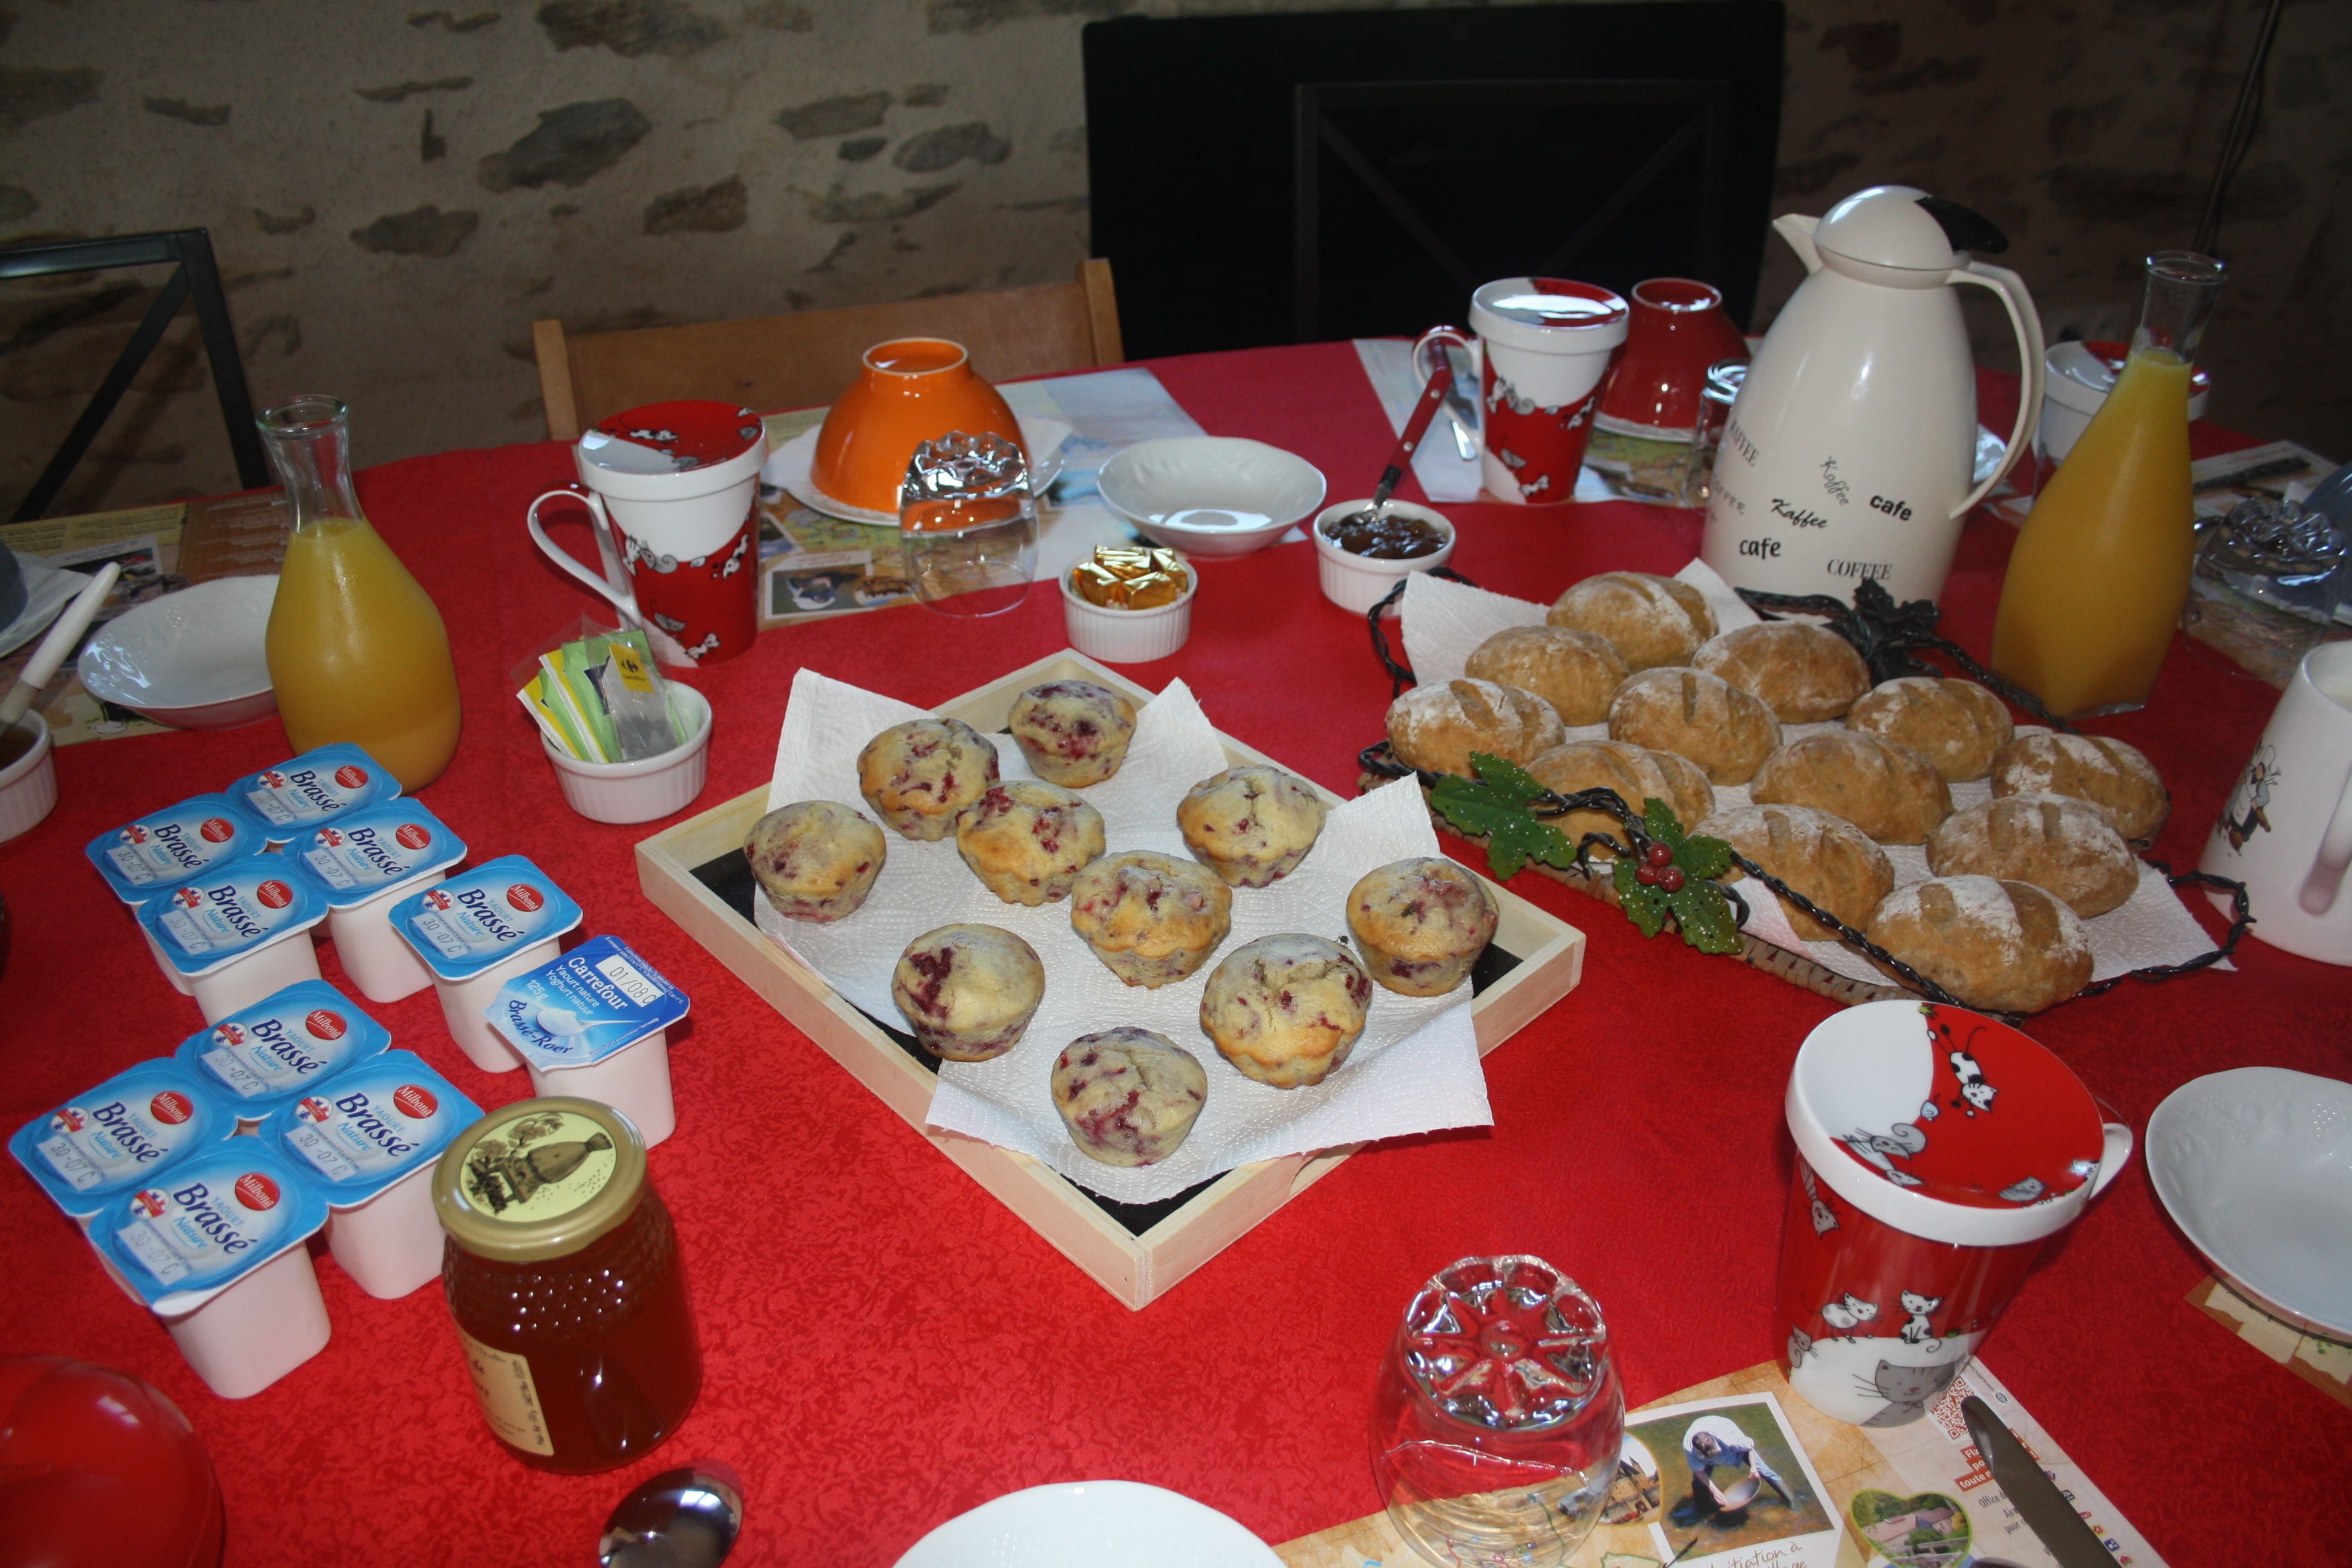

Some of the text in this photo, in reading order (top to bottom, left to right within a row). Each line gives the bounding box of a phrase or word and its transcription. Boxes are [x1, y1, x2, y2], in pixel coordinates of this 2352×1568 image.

[1770, 498, 1827, 528] Kaffee
[1869, 494, 1913, 521] cafe
[1739, 537, 1781, 560] cafe
[1827, 559, 1893, 580] COFFEE
[340, 766, 363, 787] Milbona
[287, 789, 311, 808] Nature
[290, 770, 347, 812] Brassé
[182, 832, 203, 852] YAOURT
[206, 818, 227, 841] Milbona
[400, 825, 426, 848] Milbona
[151, 844, 172, 865] Nature
[154, 824, 209, 869] Brassé
[347, 848, 372, 871] Nature
[348, 828, 411, 875] Brassé
[377, 837, 401, 858] YAOURT
[237, 895, 262, 918] YAOURT
[263, 881, 287, 907] Milbona
[511, 885, 538, 910] Milbona
[204, 909, 230, 933] Nature
[208, 885, 269, 937] Brassé
[457, 889, 524, 941] Brassé
[457, 912, 484, 936] Nature
[487, 899, 514, 923] YAOURT
[527, 979, 549, 1001] 125g
[546, 970, 593, 1016] Yoghurt natuur
[555, 965, 599, 1007] Yaourt nature
[568, 956, 628, 1010] Carrefour
[310, 1011, 342, 1039] Milbona
[509, 1000, 573, 1054] Brassé-Roer
[250, 1019, 327, 1074] Brassé
[284, 1029, 315, 1053] YAOURT
[252, 1045, 284, 1071] Nature
[157, 1093, 188, 1122] Milbona
[399, 1086, 433, 1117] Milbona
[128, 1112, 157, 1138] YAOURT
[336, 1093, 420, 1157] Brassé
[372, 1105, 405, 1132] YAOURT
[91, 1131, 122, 1159] Nature
[93, 1102, 169, 1163] Brassé
[338, 1122, 373, 1151] Nature
[240, 1174, 274, 1207] Milbona
[174, 1183, 258, 1254] Brassé
[212, 1197, 244, 1227] YAOURT
[174, 1216, 208, 1249] Nature
[1959, 1472, 1986, 1488] toute
[1978, 1494, 2001, 1508] Office
[1789, 1541, 1802, 1553] à
